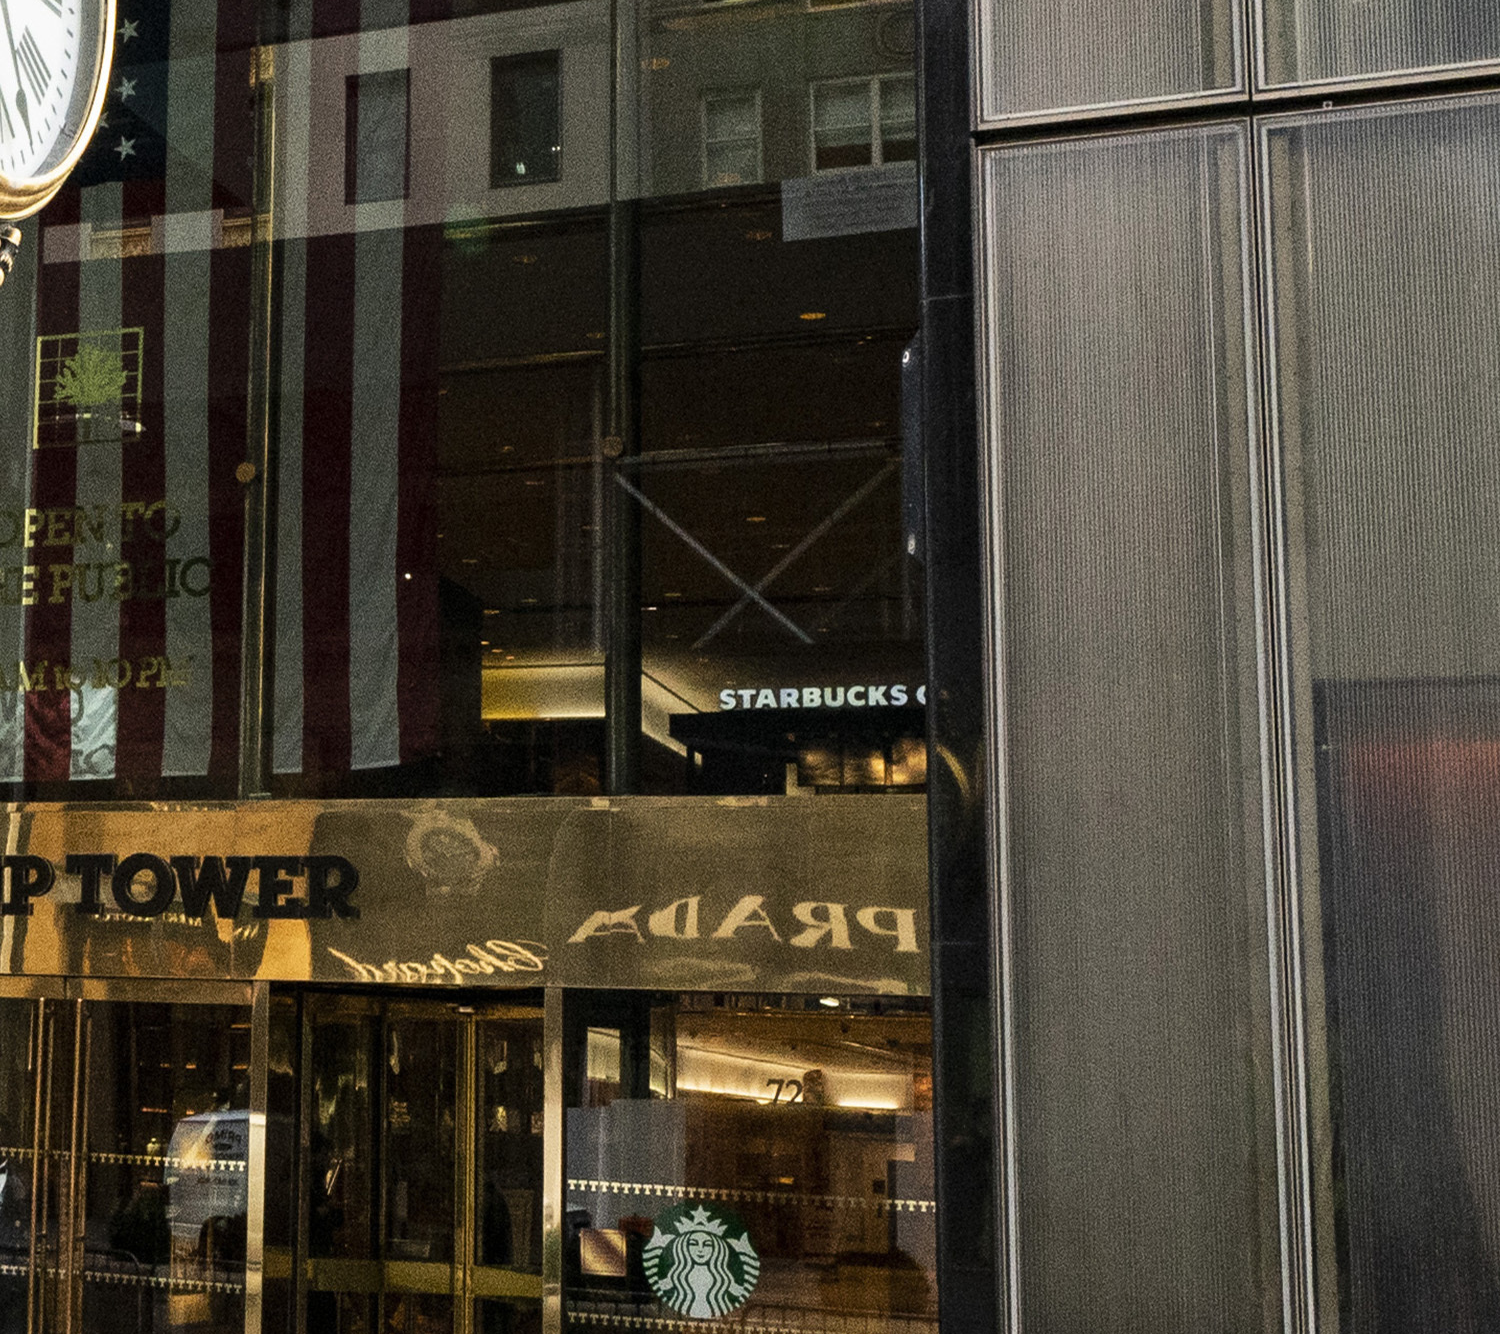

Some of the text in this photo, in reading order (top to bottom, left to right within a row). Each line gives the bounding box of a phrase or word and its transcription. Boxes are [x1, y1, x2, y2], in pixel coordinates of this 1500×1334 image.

[119, 499, 182, 543] TO
[718, 684, 909, 710] STARBUCKS
[67, 852, 362, 919] TOWER
